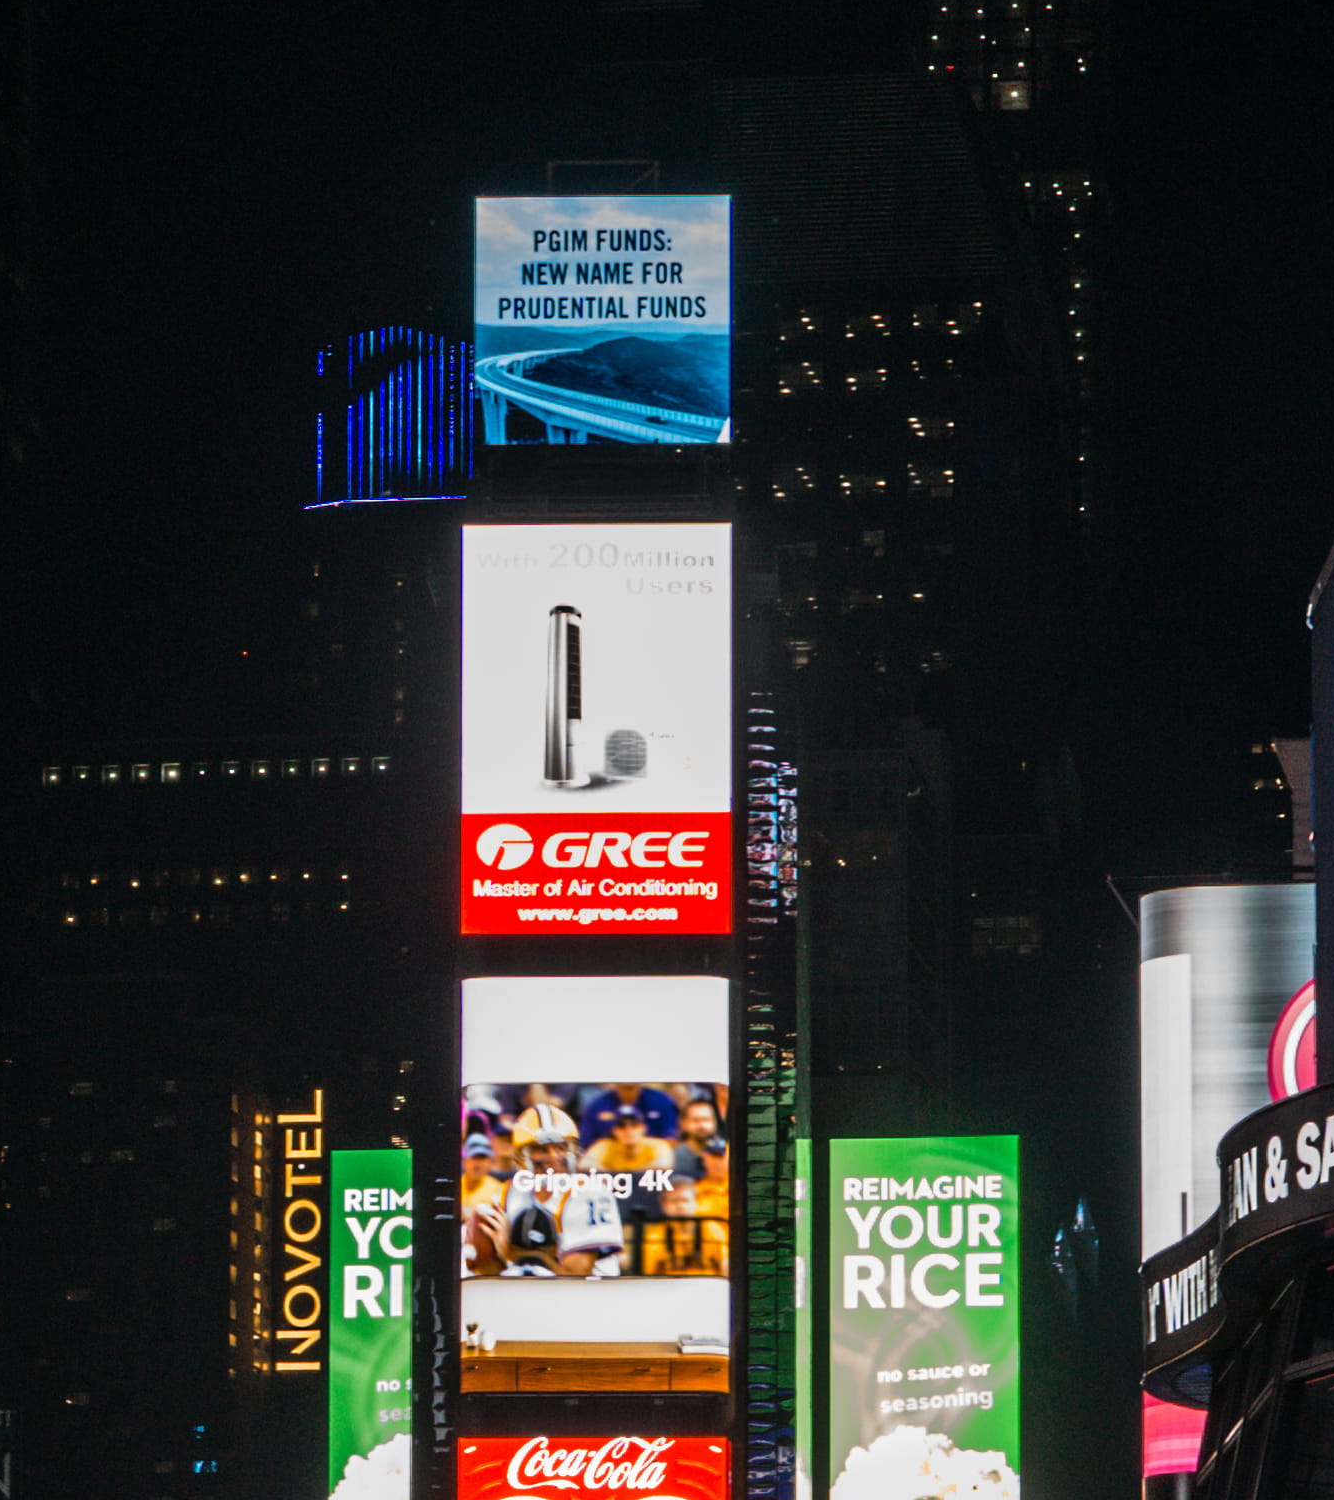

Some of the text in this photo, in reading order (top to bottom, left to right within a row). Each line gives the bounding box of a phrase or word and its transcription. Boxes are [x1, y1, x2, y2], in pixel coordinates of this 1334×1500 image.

[533, 228, 672, 252] PGIM FUNDS:
[522, 261, 683, 285] NEW NAME FOR
[498, 296, 706, 319] PRUDENTIAL FUNDS
[549, 543, 620, 569] 200
[623, 550, 715, 568] Million
[625, 576, 714, 595] Users
[541, 831, 711, 868] GREE
[473, 878, 718, 900] Master of Air Conditioning
[517, 907, 678, 925] www.gree.com
[1264, 1134, 1289, 1204] &
[512, 1169, 674, 1199] Gripping 4K
[843, 1175, 1002, 1201] REIMAGINE
[276, 1088, 324, 1372] NOVOTEL
[844, 1204, 1002, 1249] YOUR
[843, 1252, 1004, 1309] RICE
[1163, 1253, 1211, 1335] WITH
[376, 1377, 400, 1392] no
[876, 1361, 991, 1383] no sauce or
[879, 1388, 993, 1414] seasoning
